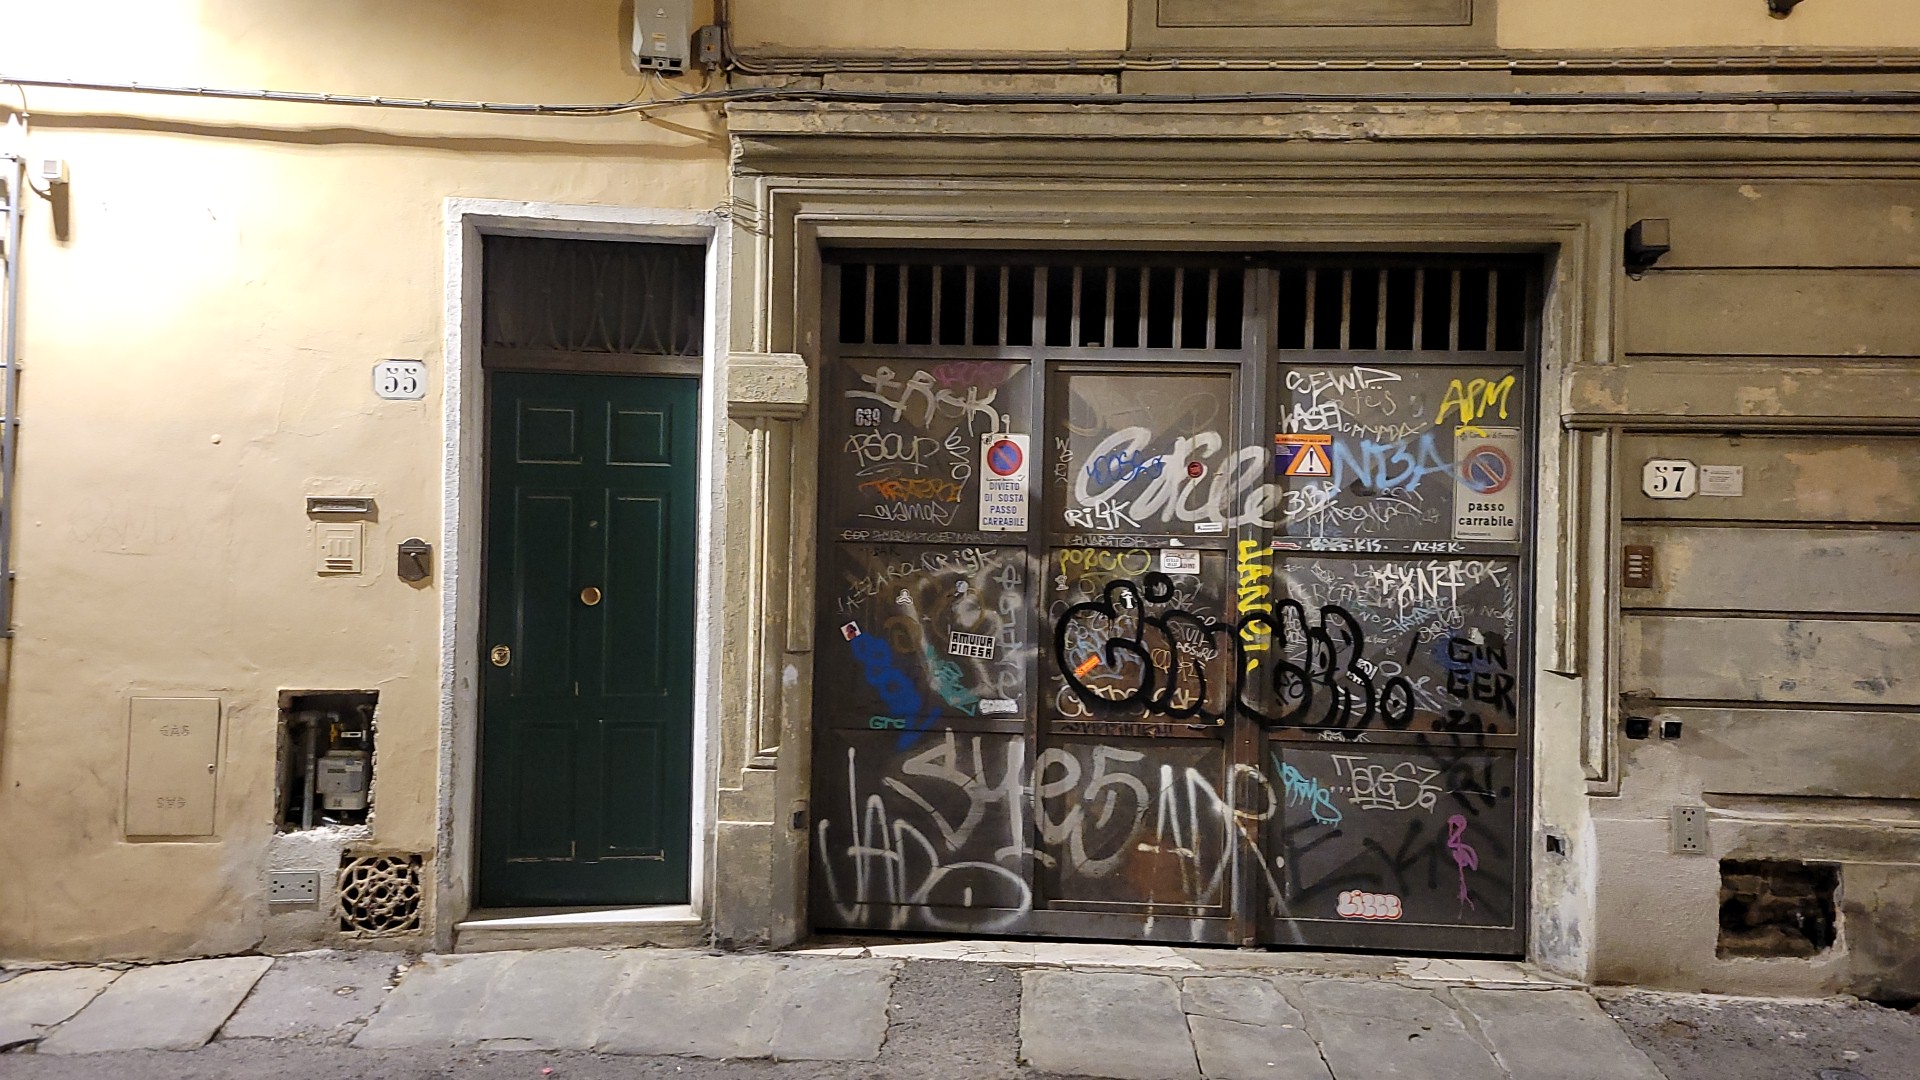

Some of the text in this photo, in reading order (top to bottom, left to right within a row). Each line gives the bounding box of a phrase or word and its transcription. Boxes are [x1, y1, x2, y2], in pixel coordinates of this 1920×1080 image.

[384, 367, 417, 393] 55
[855, 408, 880, 427] 639
[1653, 466, 1687, 492] 57
[989, 482, 1020, 491] DIVIETO
[984, 493, 1025, 502] DI SOSTA
[990, 505, 1017, 515] PASSO
[1468, 502, 1505, 513] passo
[983, 517, 1025, 527] CARRABILE
[1458, 516, 1514, 527] carrabile
[160, 725, 190, 737] GAS
